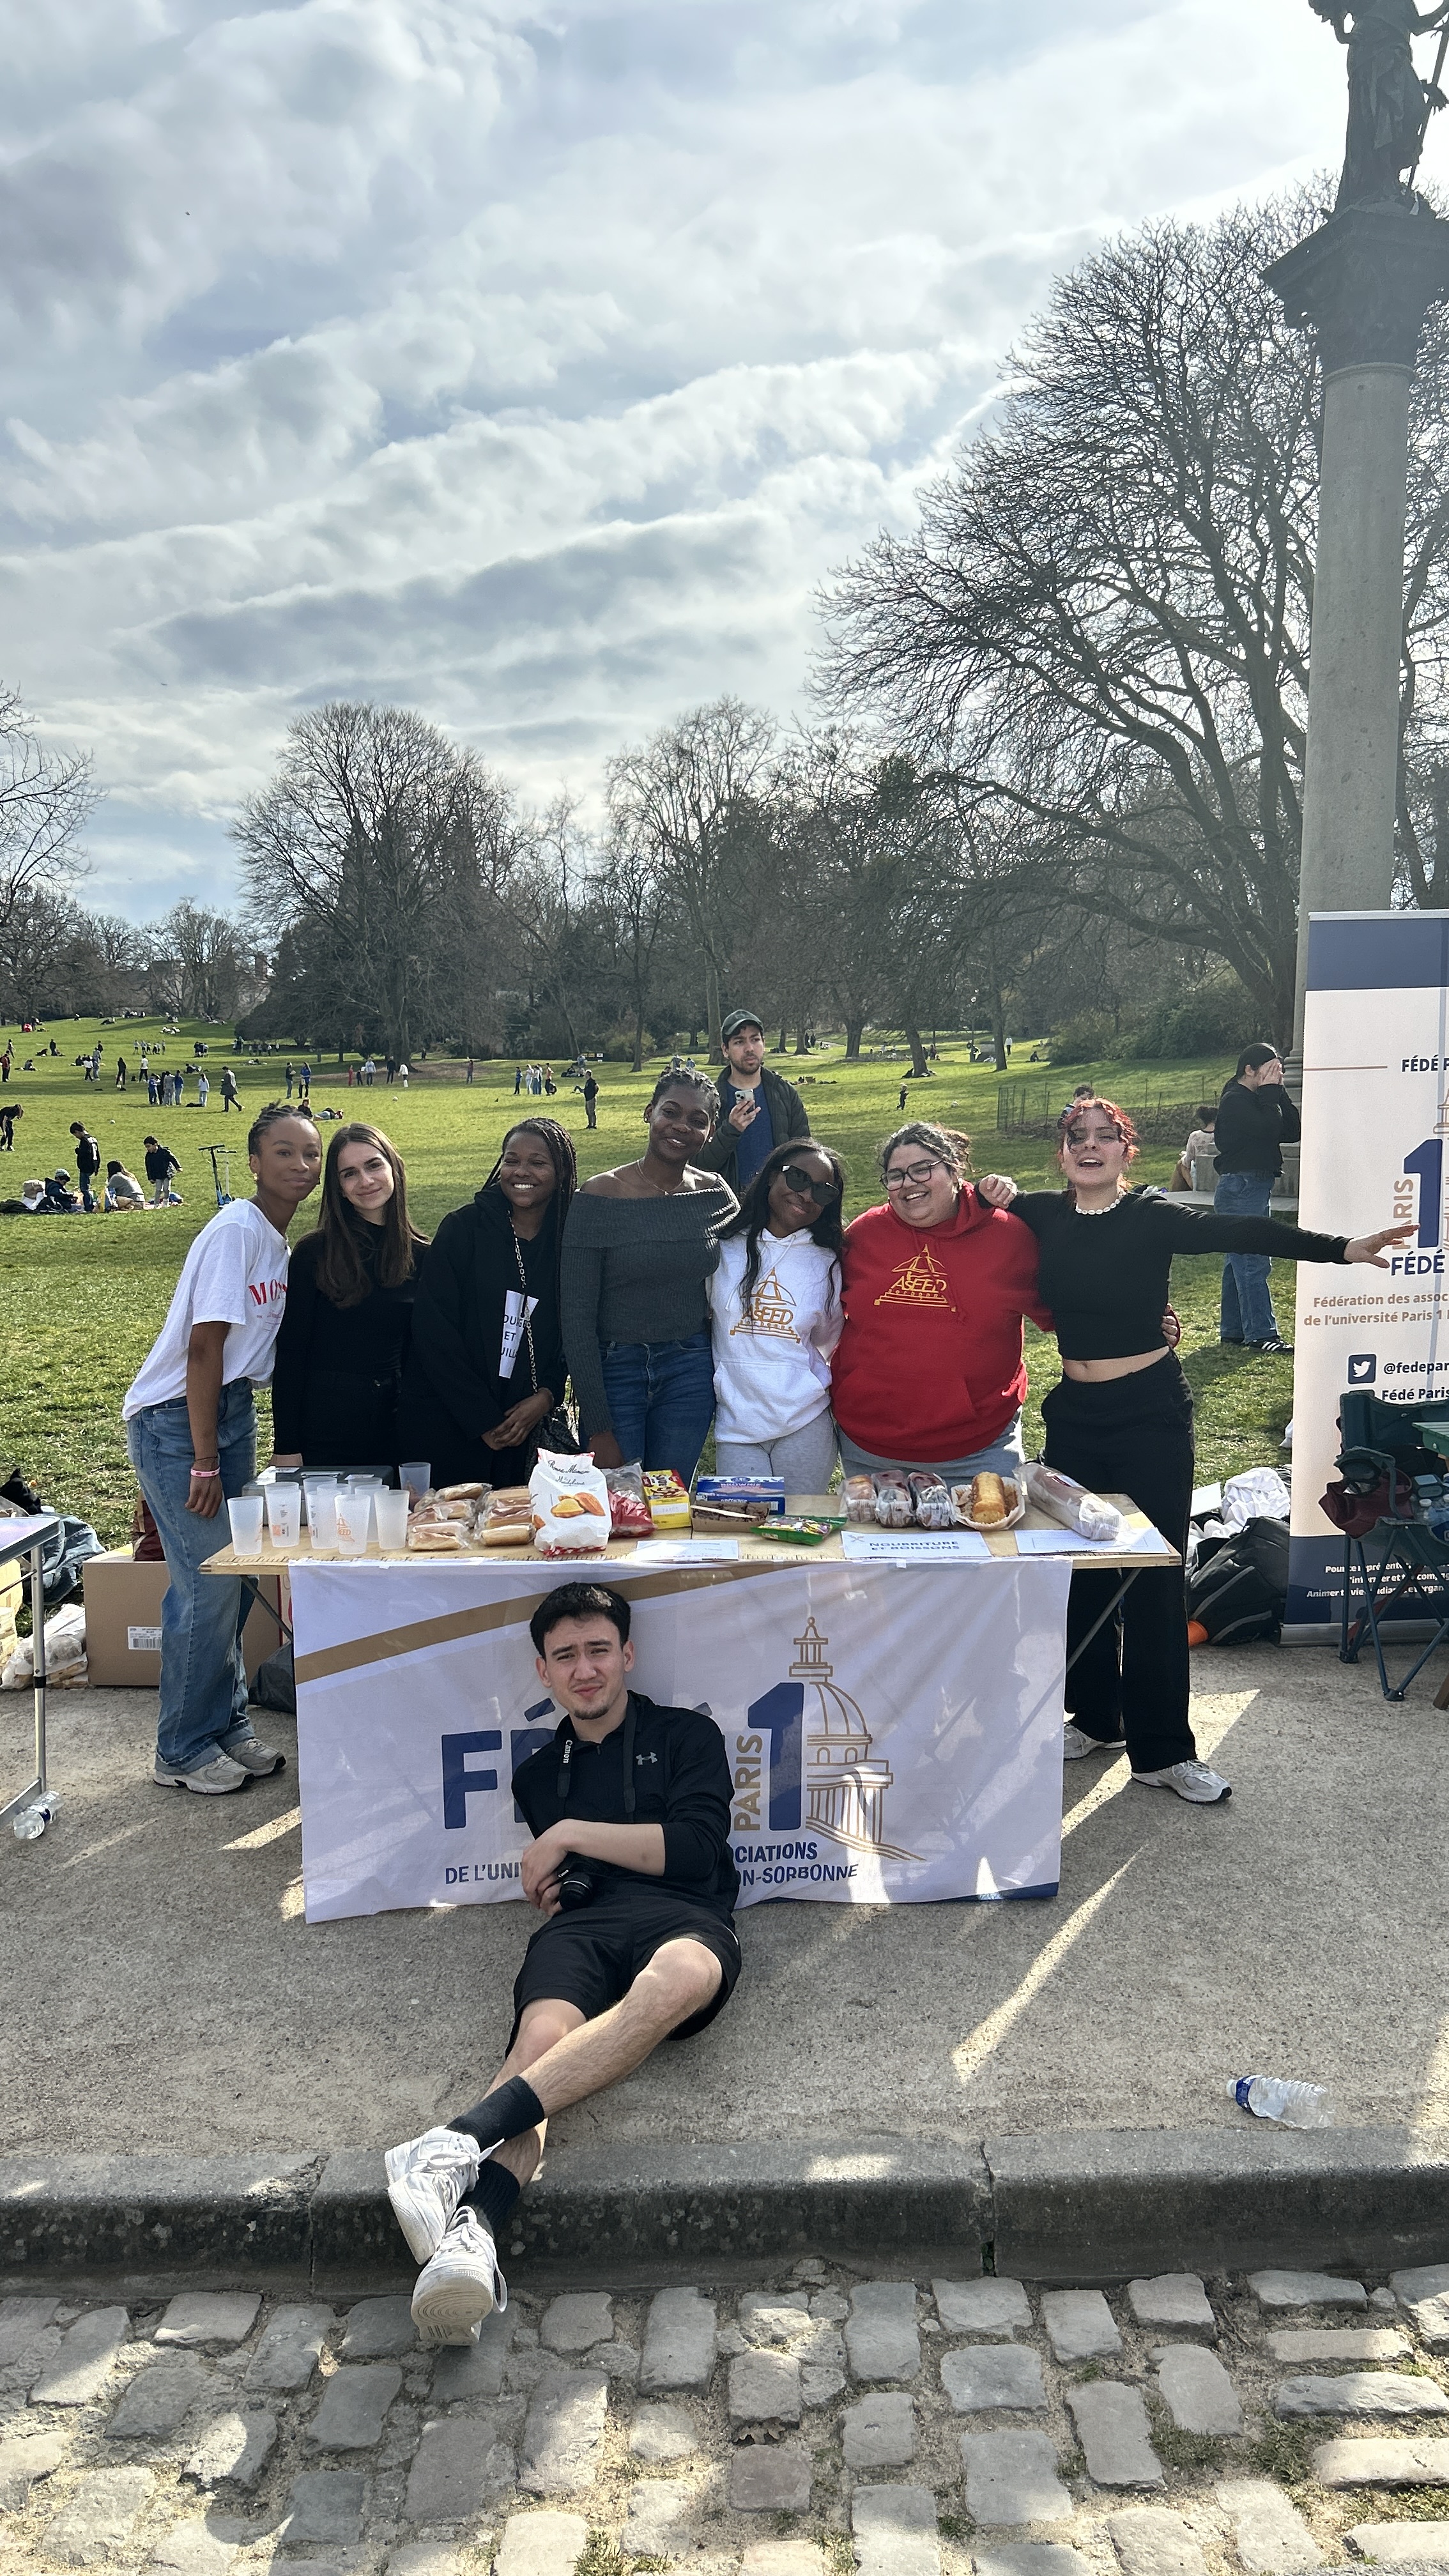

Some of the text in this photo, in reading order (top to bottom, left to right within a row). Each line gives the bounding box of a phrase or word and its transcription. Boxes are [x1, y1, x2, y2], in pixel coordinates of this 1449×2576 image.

[1402, 1054, 1439, 1072] FÉDÉ
[1403, 1138, 1443, 1248] 1
[1392, 1179, 1414, 1250] PRIS
[1391, 1249, 1445, 1276] FÉDÉ
[1313, 1293, 1448, 1308] Fédération des assoc
[1303, 1309, 1442, 1326] de l'université Paris 1
[504, 1331, 516, 1341] ET
[1382, 1388, 1414, 1400] Fédé
[1307, 1589, 1340, 1597] Animer
[563, 1739, 573, 1763] Canon
[747, 1682, 805, 1831] 1
[733, 1734, 763, 1831] PARIS
[445, 1862, 859, 1886] DE L'UNI N-SORBONNE
